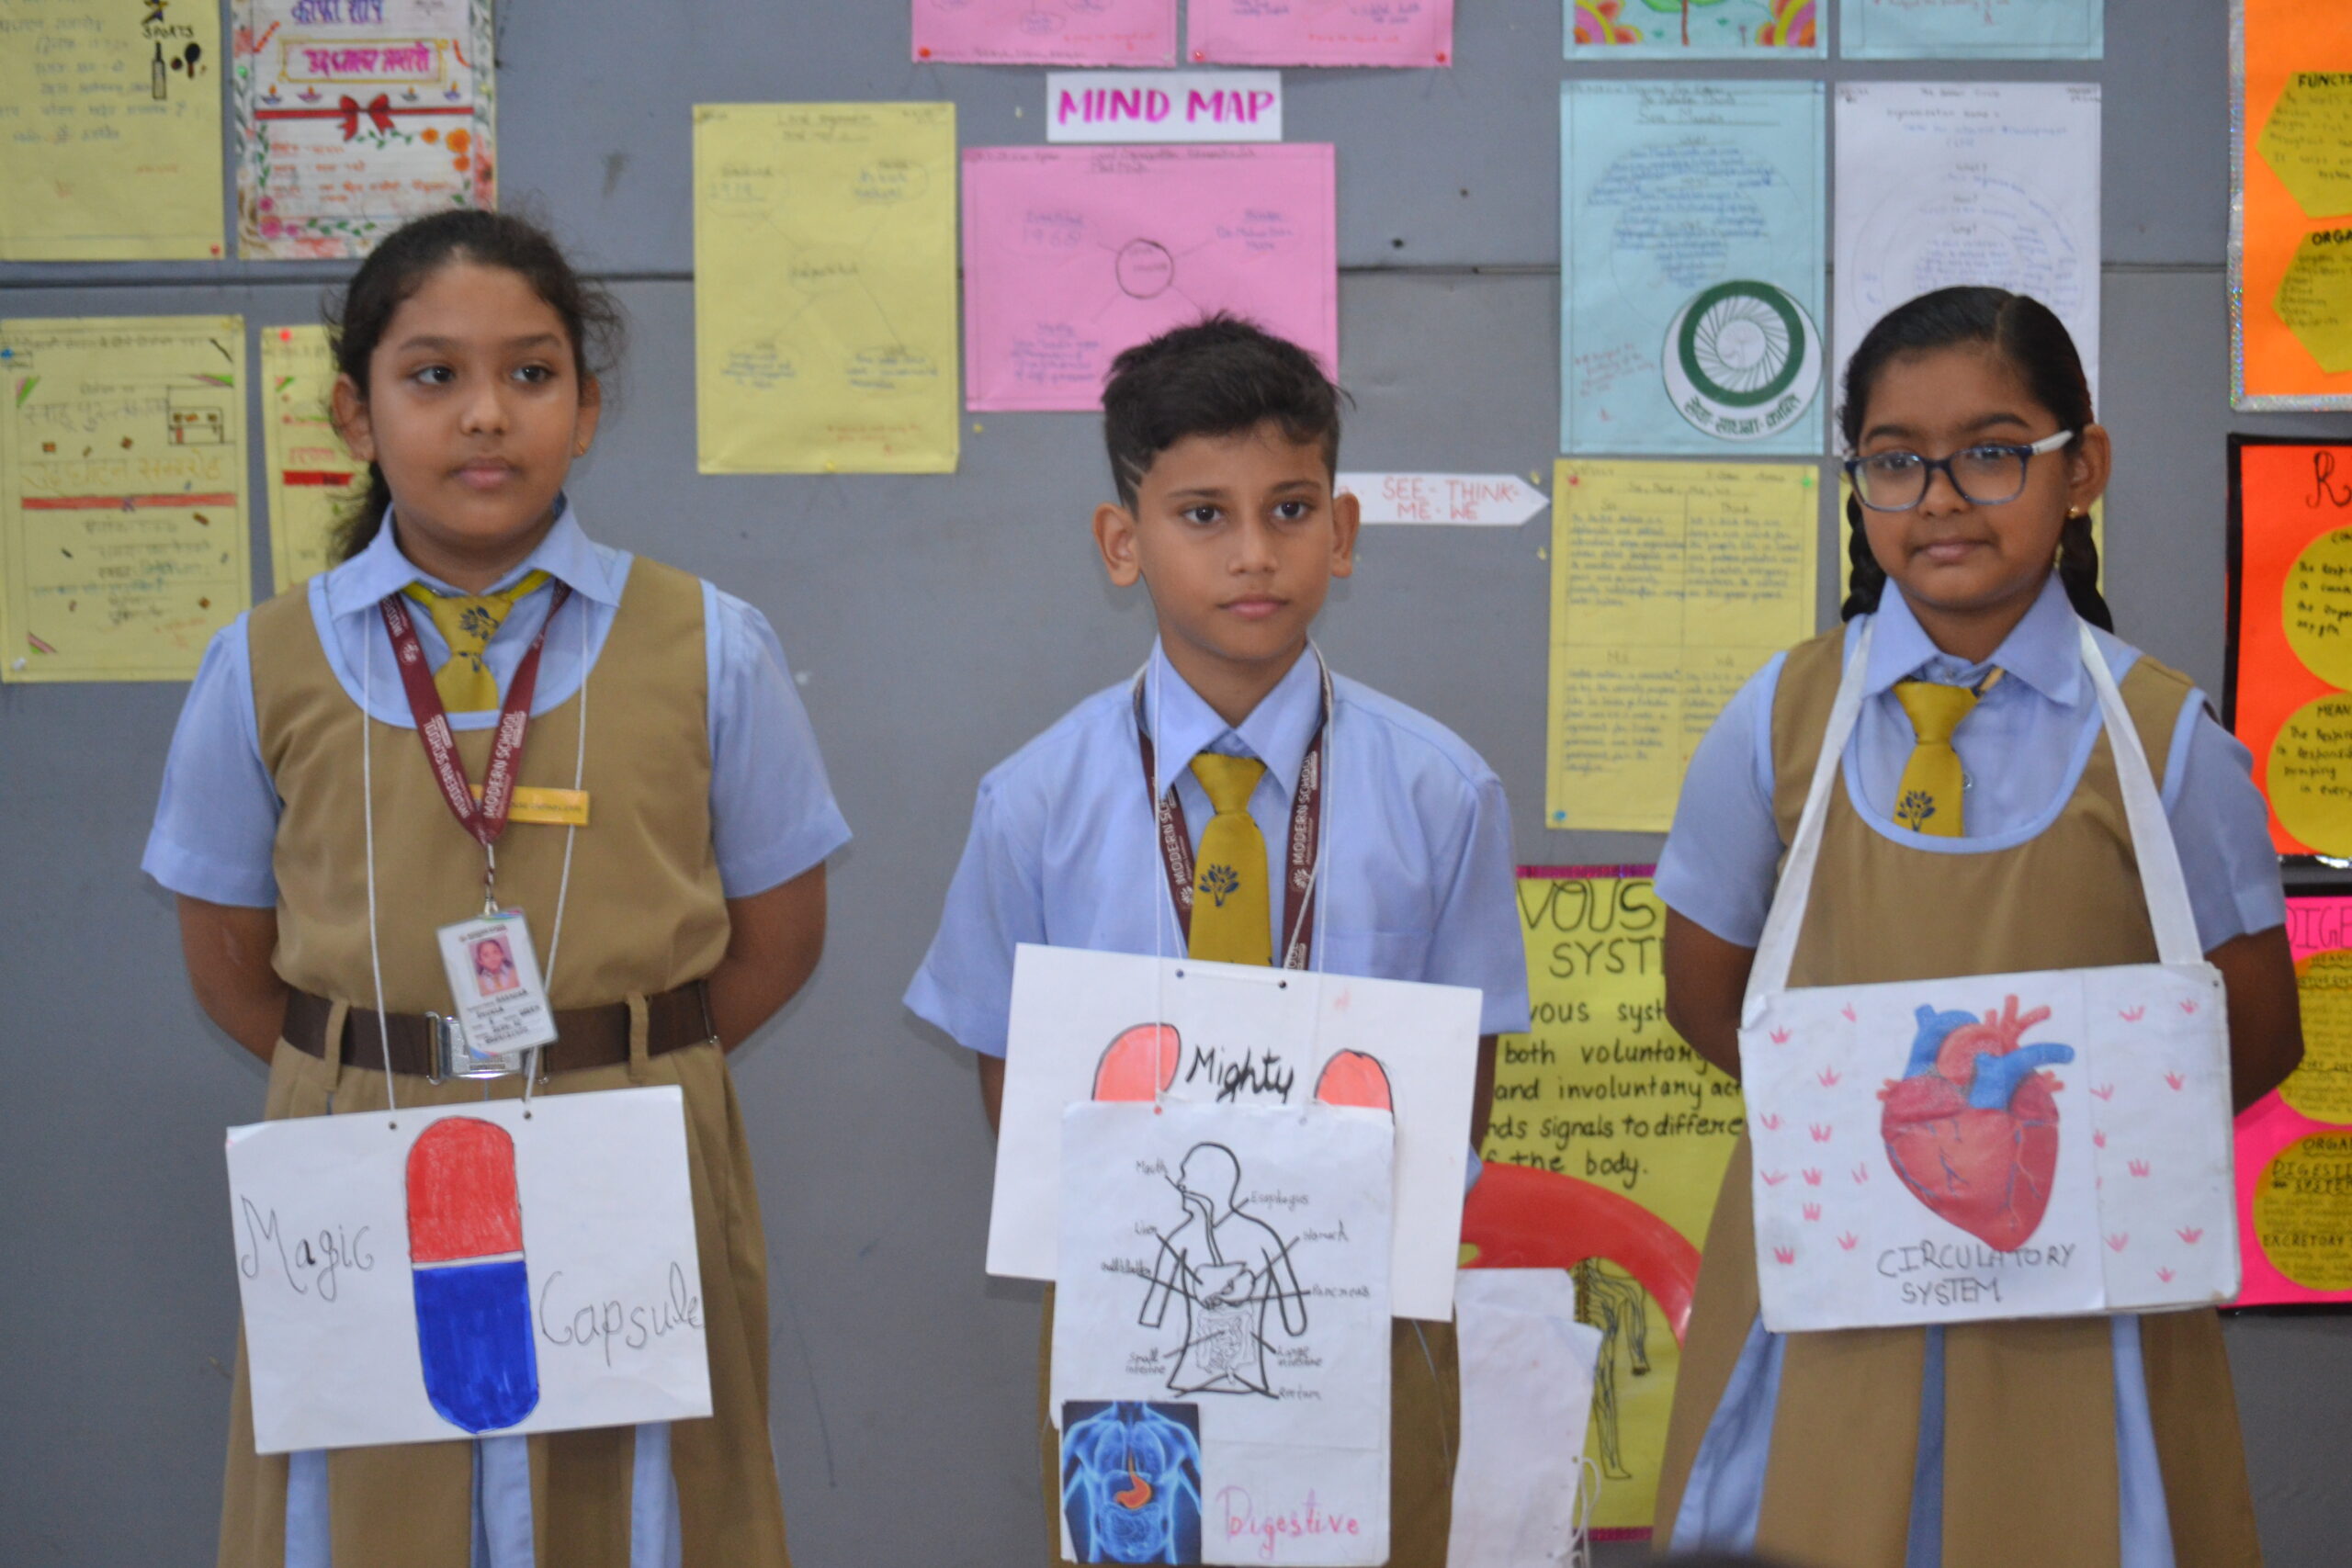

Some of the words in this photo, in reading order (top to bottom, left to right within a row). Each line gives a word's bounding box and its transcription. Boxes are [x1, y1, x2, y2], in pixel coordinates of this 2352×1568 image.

[1057, 89, 1170, 125] MIND
[1187, 89, 1275, 123] MAP
[482, 759, 509, 819] MODERN
[1162, 823, 1187, 886] MODERN
[1292, 804, 1309, 866] MODERN
[1517, 879, 1657, 933] VOUS
[1186, 1045, 1295, 1103] Mighty
[1505, 1040, 1556, 1065] both
[1495, 1077, 1541, 1100] and
[1559, 1077, 1702, 1111] involuntary
[1540, 1116, 1614, 1150] signals
[1625, 1111, 1653, 1138] to
[1586, 1151, 1648, 1190] body.
[242, 1194, 376, 1303] Magic
[1876, 1241, 2076, 1280] CIRCULATORY
[539, 1261, 707, 1367] Capsule
[1901, 1278, 2003, 1305] SYSTEM
[1216, 1483, 1361, 1562] Digestive
